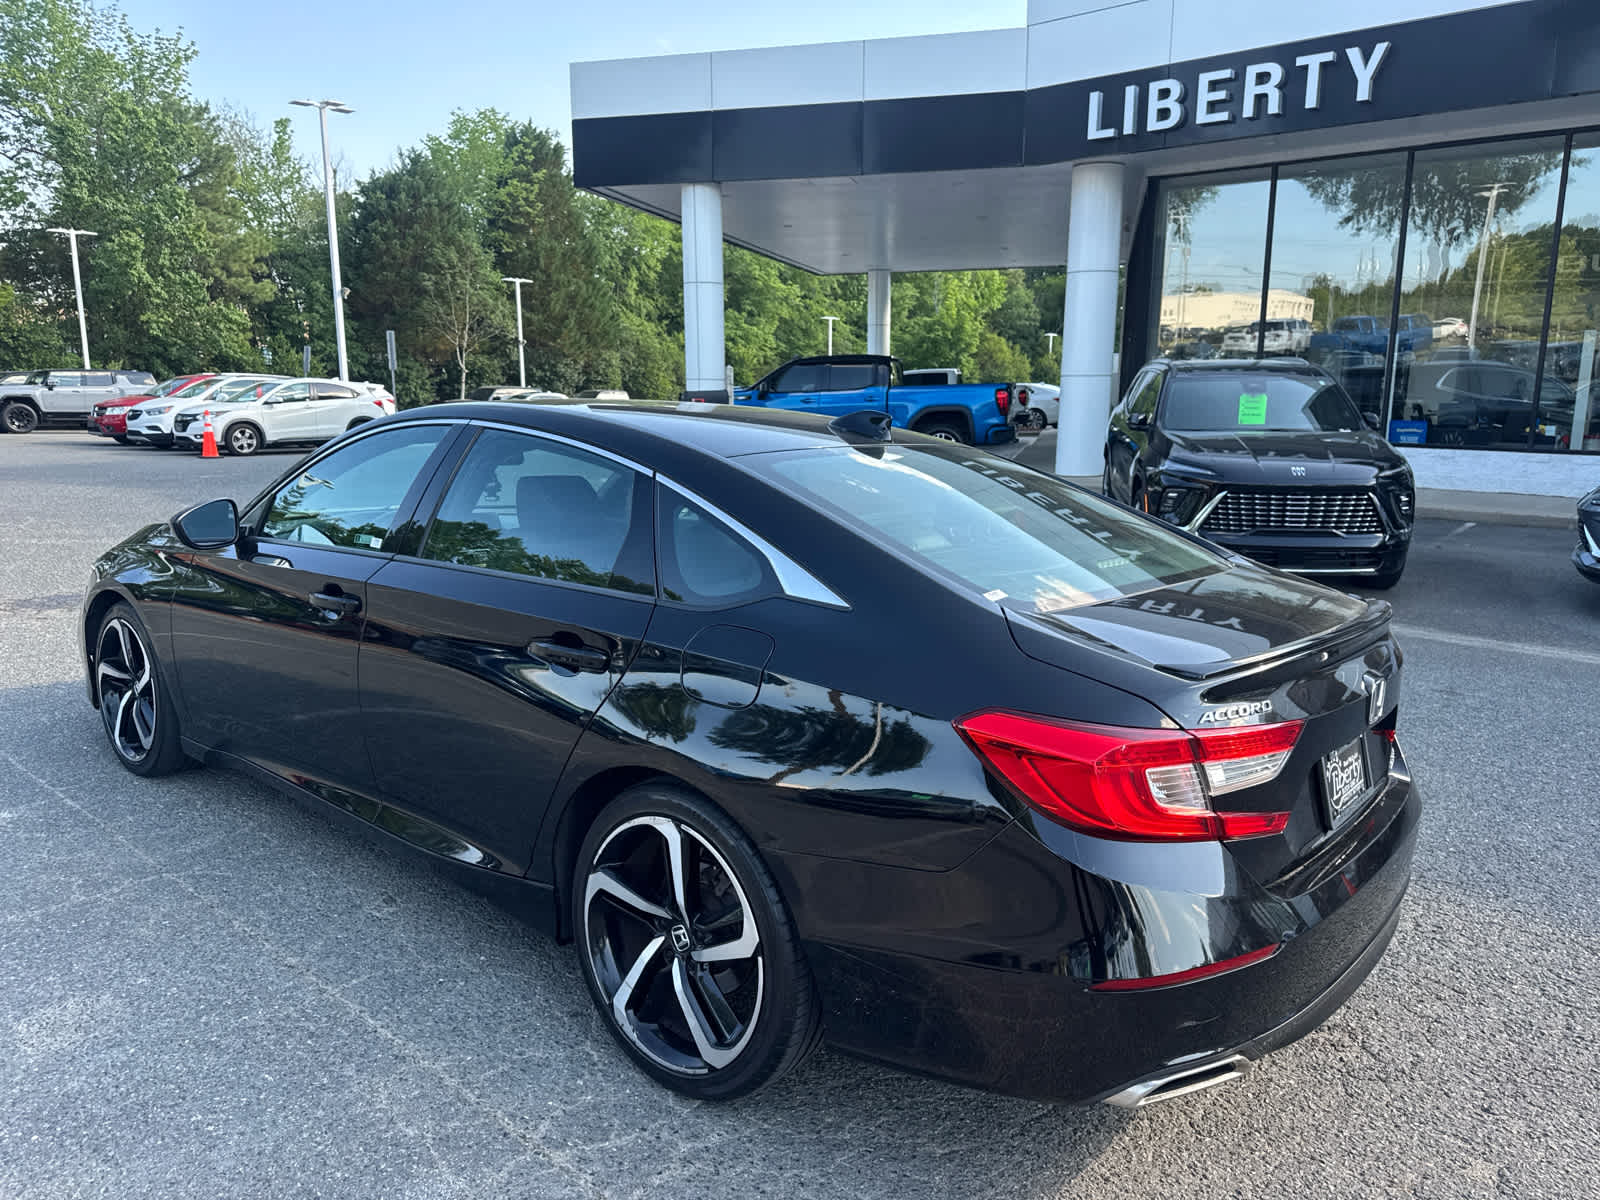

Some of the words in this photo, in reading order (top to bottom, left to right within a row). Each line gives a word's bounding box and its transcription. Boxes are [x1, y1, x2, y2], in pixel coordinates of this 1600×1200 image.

[1087, 41, 1392, 141] LIBERTY
[1198, 700, 1272, 724] ACCORD
[1331, 754, 1363, 800] Liberty
